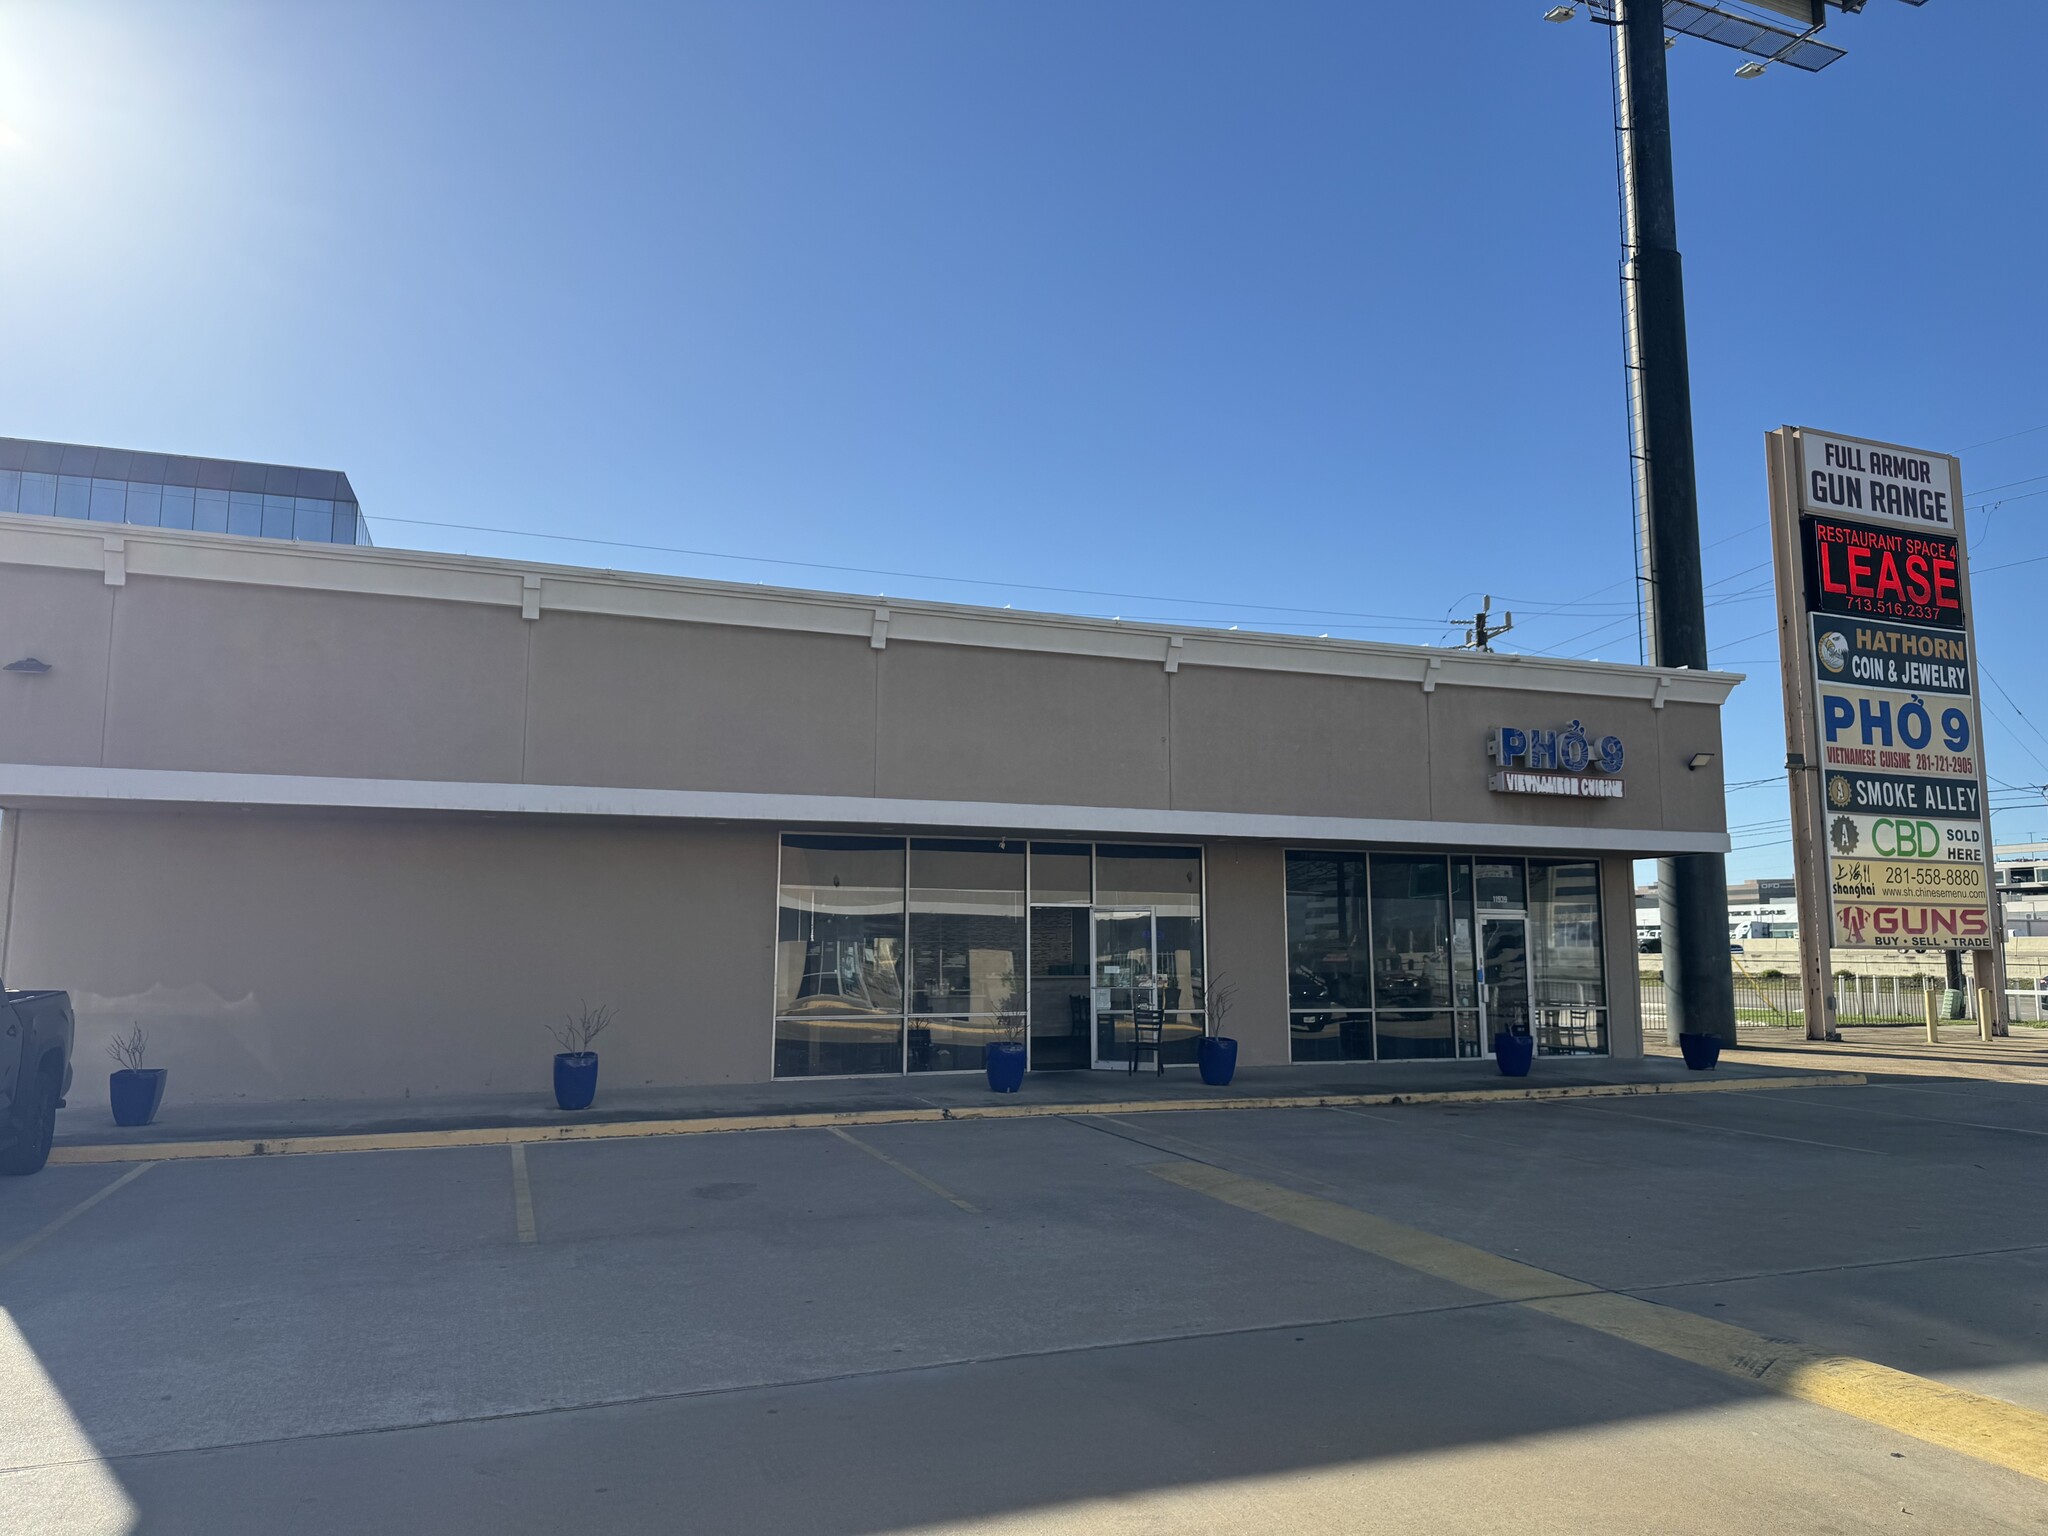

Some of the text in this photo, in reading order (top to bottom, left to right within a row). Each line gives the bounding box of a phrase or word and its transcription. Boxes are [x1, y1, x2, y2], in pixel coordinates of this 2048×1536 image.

[1825, 443, 1931, 484] FULL ARMOR
[1812, 470, 1948, 523] GUN RANGE
[1817, 524, 1956, 560] RESTAURANT SPACE 4
[1821, 542, 1959, 609] LEASE
[1846, 596, 1940, 620] 713.516.2337
[1856, 628, 1965, 661] HATHORN
[1852, 655, 1966, 689] COIN & JEWELRY
[1941, 707, 1970, 752] 9
[1600, 735, 1625, 774] 9
[1827, 746, 1973, 774] VIETNAMESE CUISINE 281-721-2905
[1856, 780, 1977, 812] SMOKE ALLEY
[1872, 818, 1940, 858] CBD
[1946, 829, 1980, 843] SOLD
[1948, 847, 1981, 861] HERE
[1882, 886, 1986, 899] www.sh.chinesemenu.com
[1885, 867, 1979, 886] 281-558-8880
[1873, 907, 1988, 936] GUNS
[1875, 936, 1990, 947] BUY SELL TRADE
